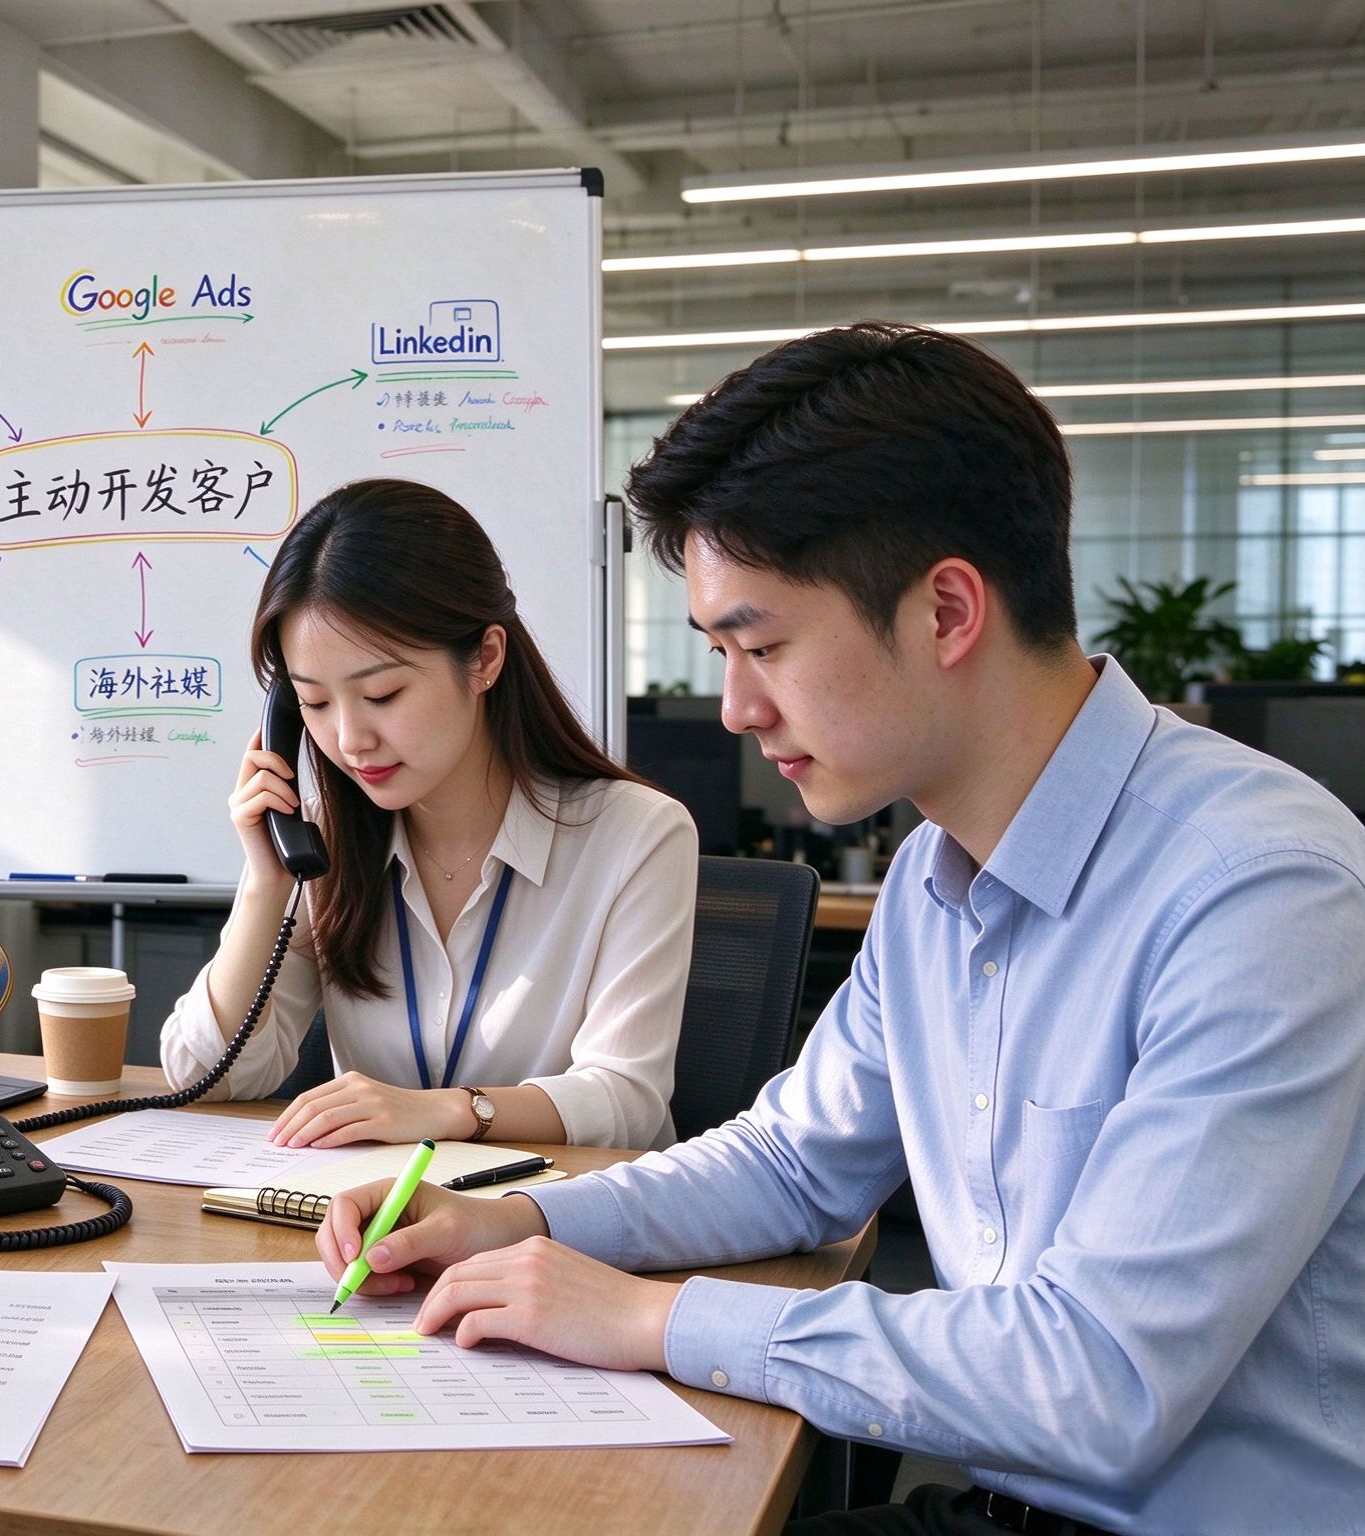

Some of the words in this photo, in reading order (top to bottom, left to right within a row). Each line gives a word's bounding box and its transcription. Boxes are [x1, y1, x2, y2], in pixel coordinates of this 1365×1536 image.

[65, 273, 177, 321] Google
[191, 273, 252, 308] Ads
[379, 324, 492, 355] Linkedin
[89, 665, 212, 700] 海外社媒
